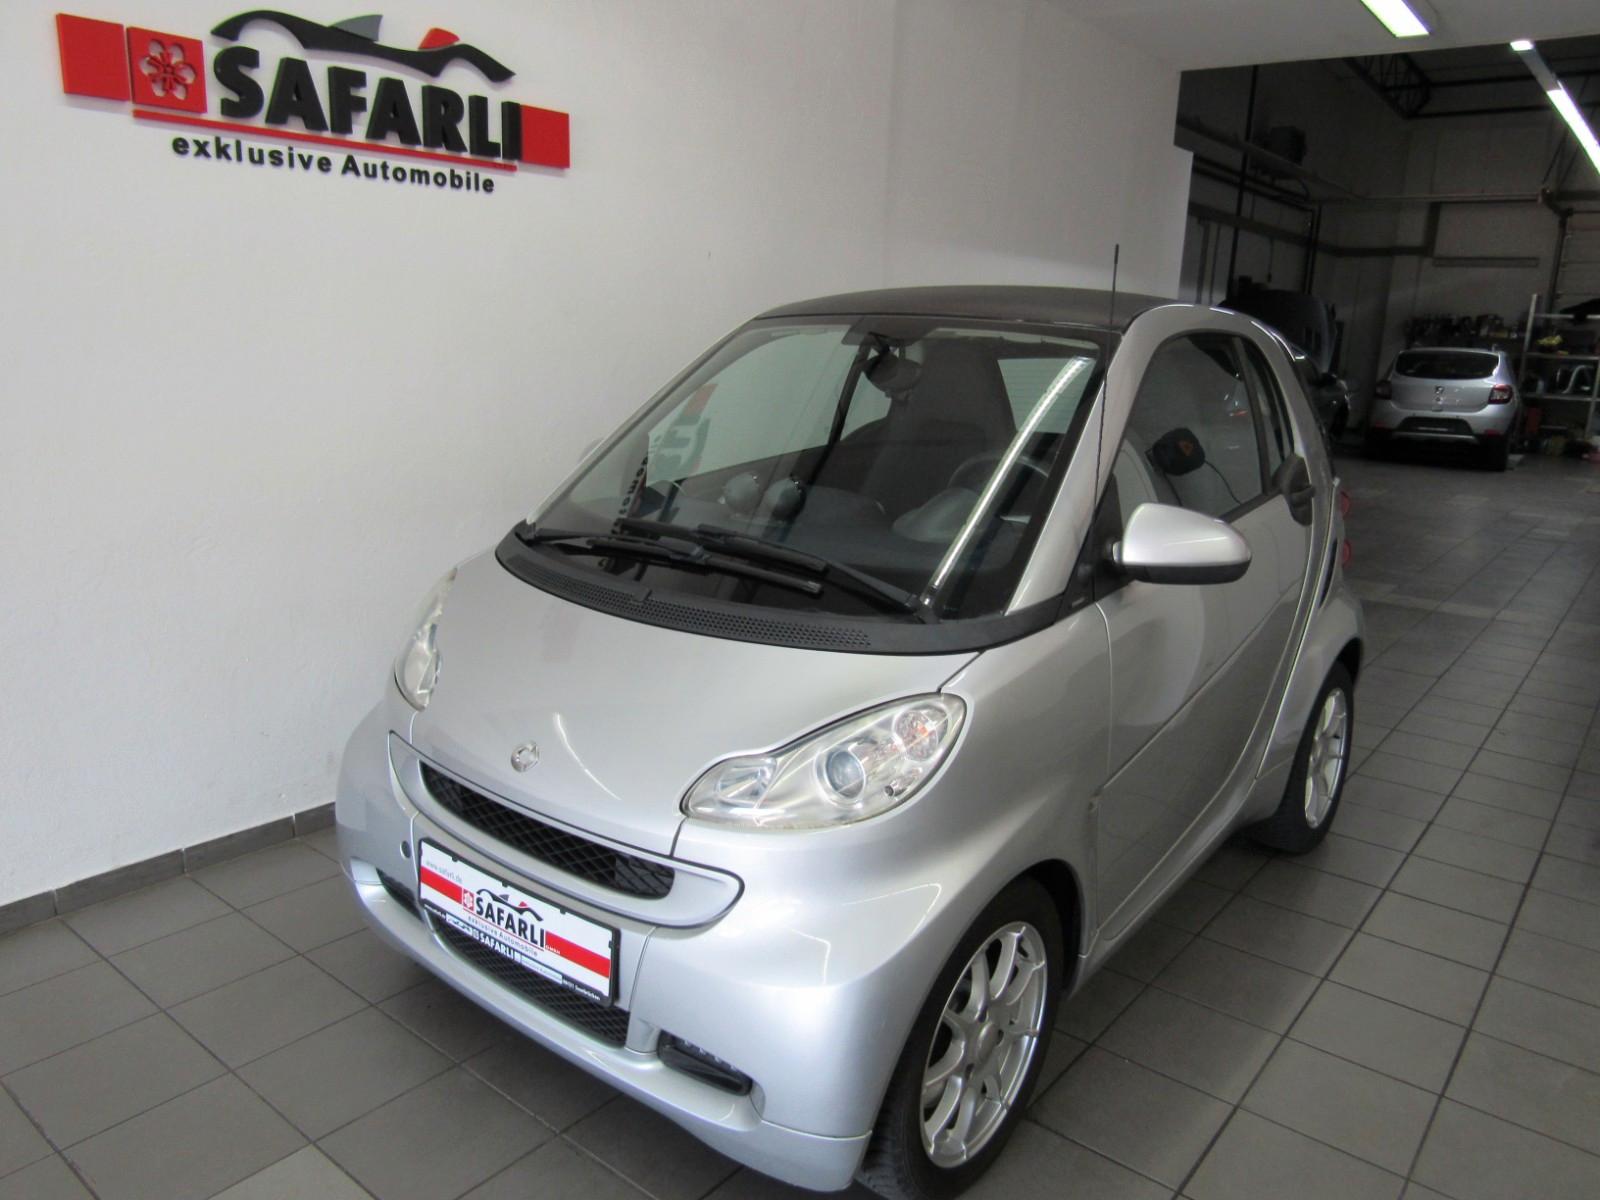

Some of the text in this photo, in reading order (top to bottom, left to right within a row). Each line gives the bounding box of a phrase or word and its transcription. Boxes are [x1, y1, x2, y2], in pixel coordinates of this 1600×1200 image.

[213, 45, 522, 161] SAFARLI
[171, 136, 495, 193] exklusive Automobile
[475, 896, 545, 948] SAFARLI
[479, 931, 515, 960] SAFARLI
